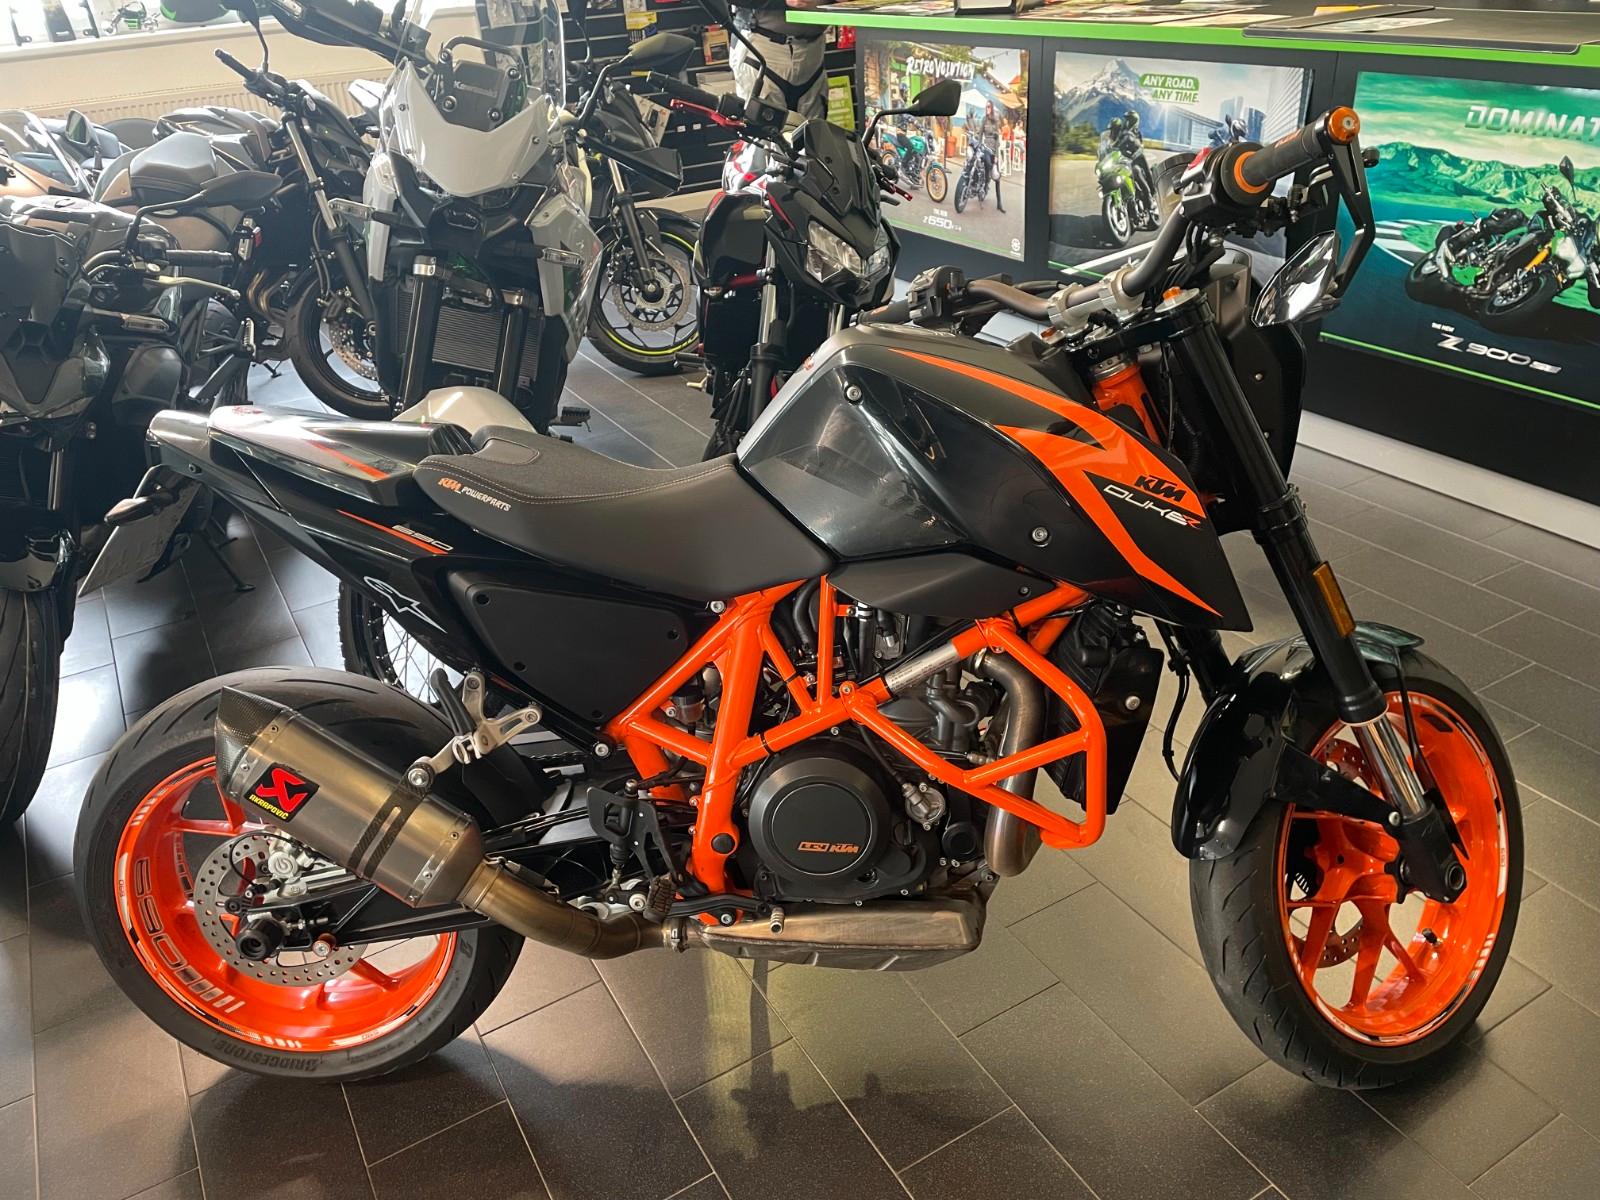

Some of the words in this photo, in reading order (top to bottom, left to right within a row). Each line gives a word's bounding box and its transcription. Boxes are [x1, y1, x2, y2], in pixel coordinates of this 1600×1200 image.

[1143, 75, 1164, 86] ANY
[1152, 88, 1173, 100] ANY
[438, 477, 462, 491] KTM
[461, 486, 511, 512] POWERPARTS
[1134, 475, 1187, 502] KTM
[1103, 484, 1188, 526] DUKE
[829, 843, 859, 853] KTM
